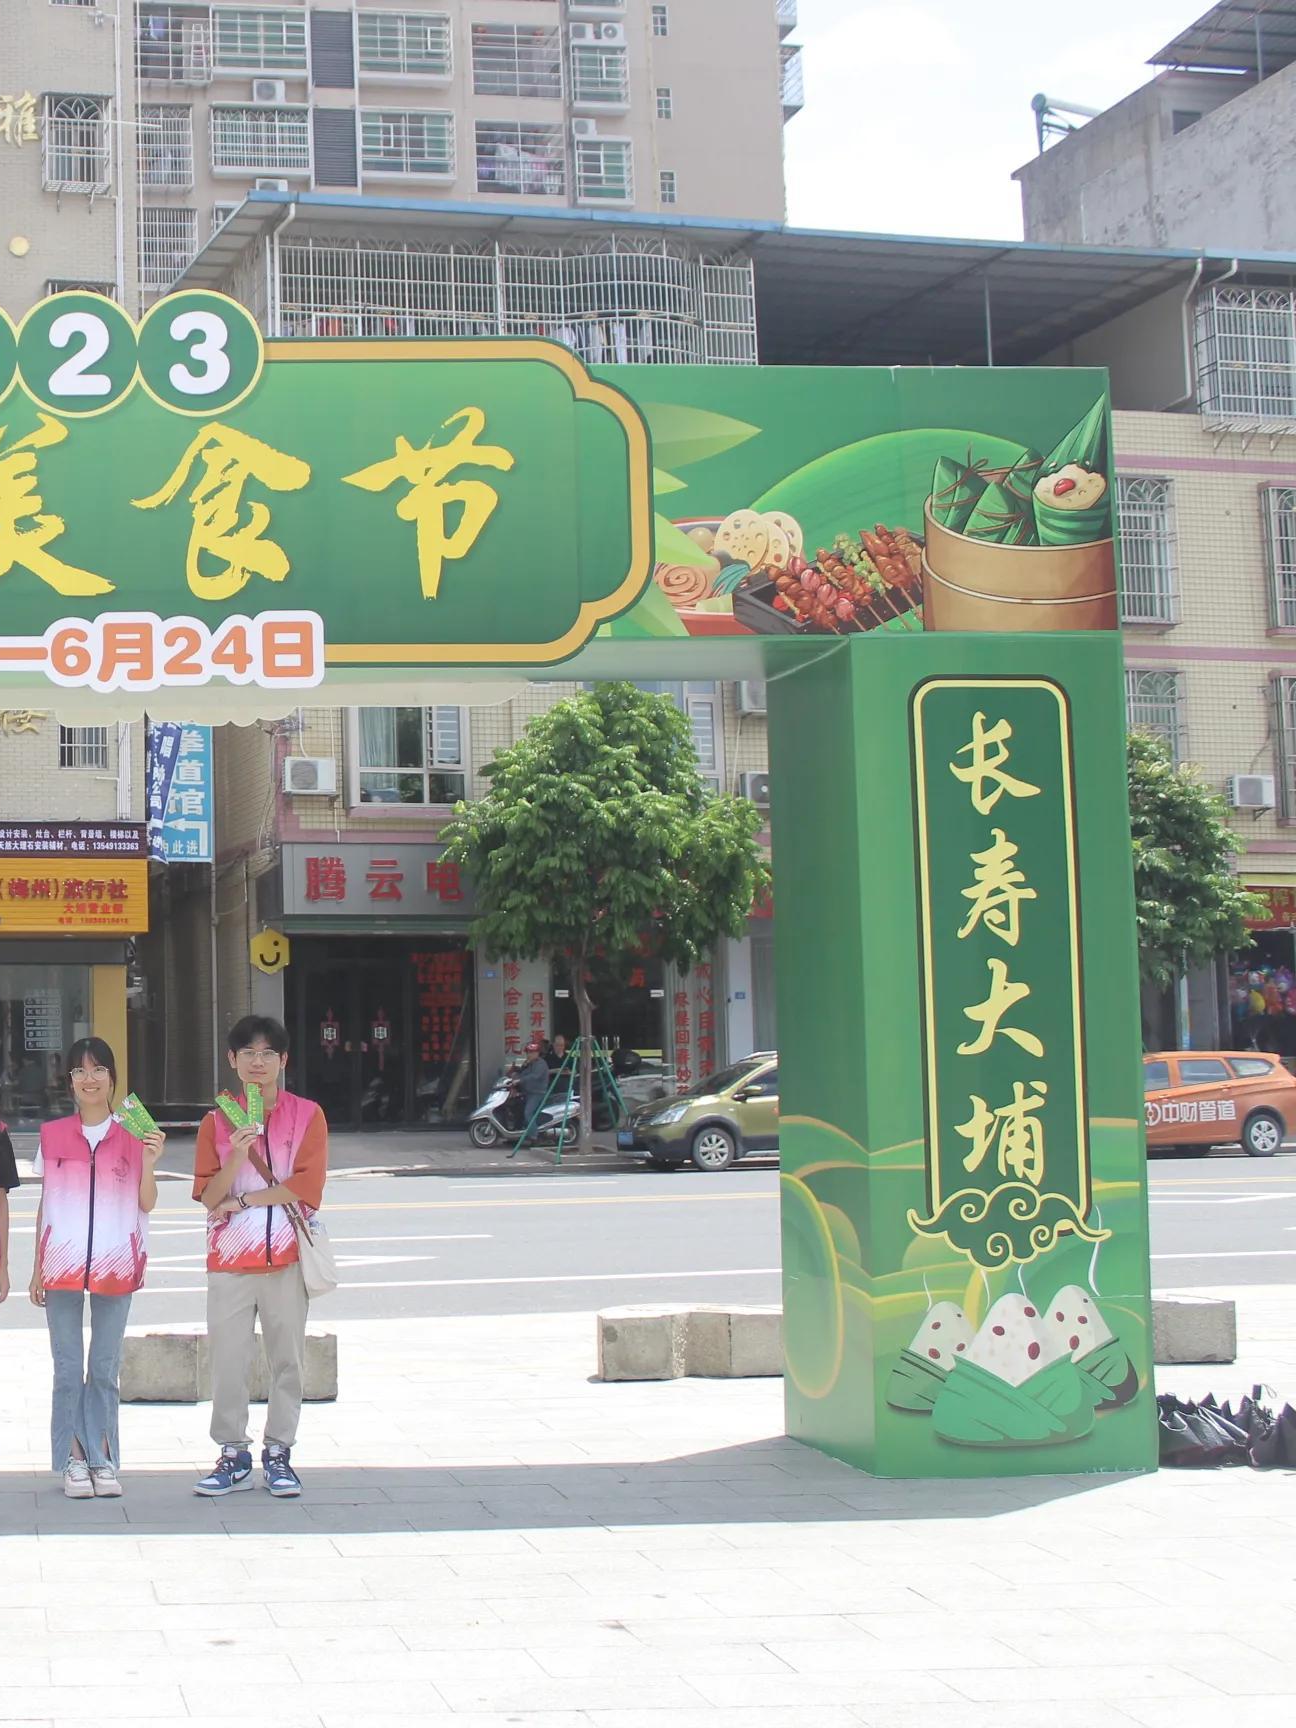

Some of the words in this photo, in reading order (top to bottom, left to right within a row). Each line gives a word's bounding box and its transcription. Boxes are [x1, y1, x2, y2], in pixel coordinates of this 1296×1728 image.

[948, 710, 1047, 1186] 长寿大埔
[1162, 1100, 1237, 1123] 中财管道
